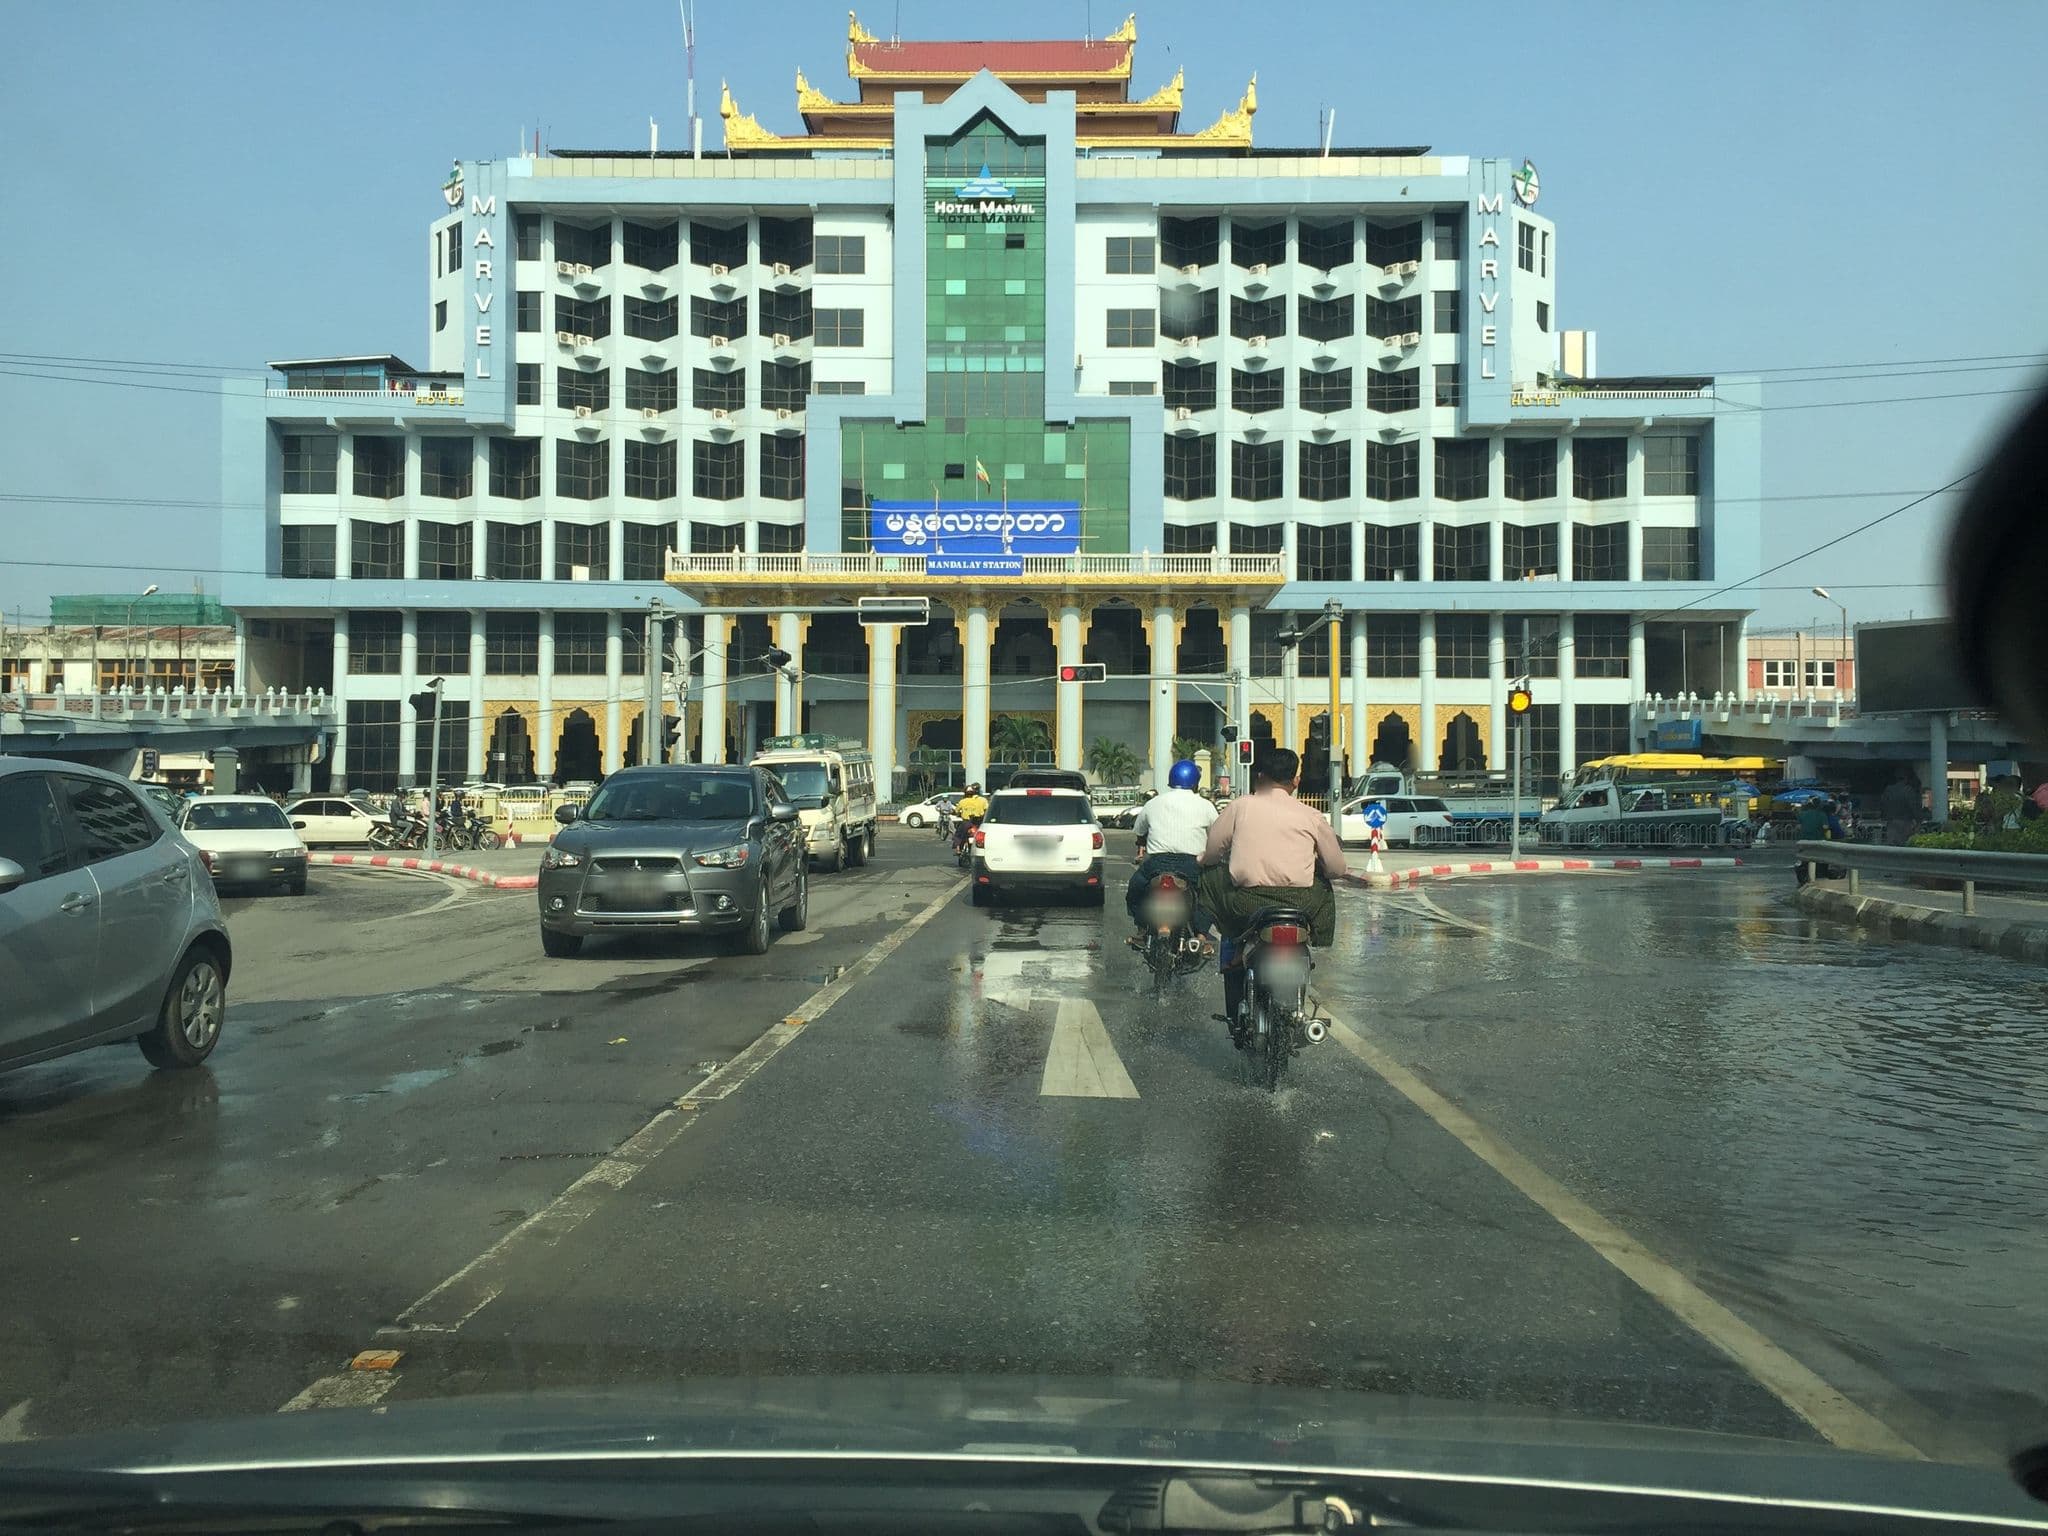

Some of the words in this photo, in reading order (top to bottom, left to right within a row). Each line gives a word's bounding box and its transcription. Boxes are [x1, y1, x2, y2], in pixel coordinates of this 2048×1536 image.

[934, 201, 977, 214] HOTEL
[980, 201, 1035, 214] MARVEL
[471, 195, 496, 379] MARVEL
[1477, 193, 1503, 379] MARVEL
[415, 395, 465, 407] HOTEL
[1511, 394, 1561, 406] HOTEL
[928, 560, 982, 569] MANDALAY
[983, 560, 1021, 569] STATION
